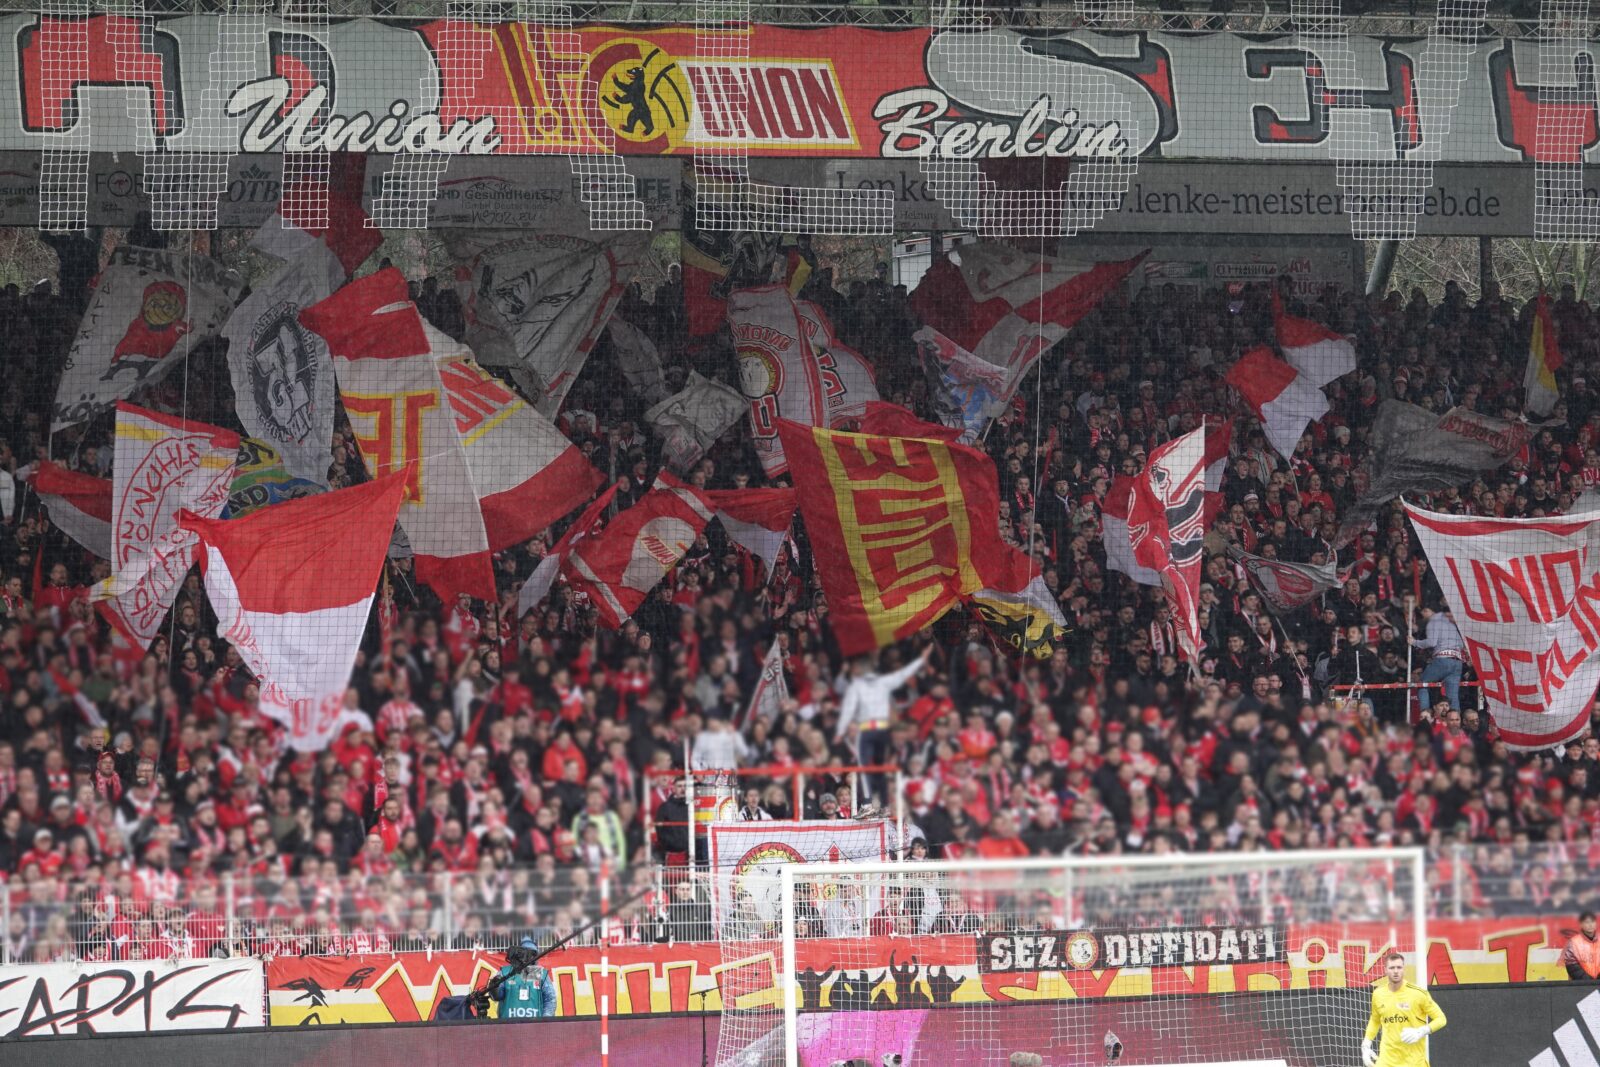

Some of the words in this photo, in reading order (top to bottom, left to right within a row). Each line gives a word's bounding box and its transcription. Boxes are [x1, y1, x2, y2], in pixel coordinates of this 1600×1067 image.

[224, 74, 504, 158] Union
[684, 63, 854, 141] UNION
[872, 90, 1131, 158] Berlin
[836, 170, 937, 202] Lenke
[1444, 548, 1588, 624] UNIO
[990, 936, 1067, 970] SEZ.
[1103, 927, 1277, 968] DIFFIDATI
[508, 1007, 538, 1018] HOST
[1383, 1013, 1410, 1023] wefox
